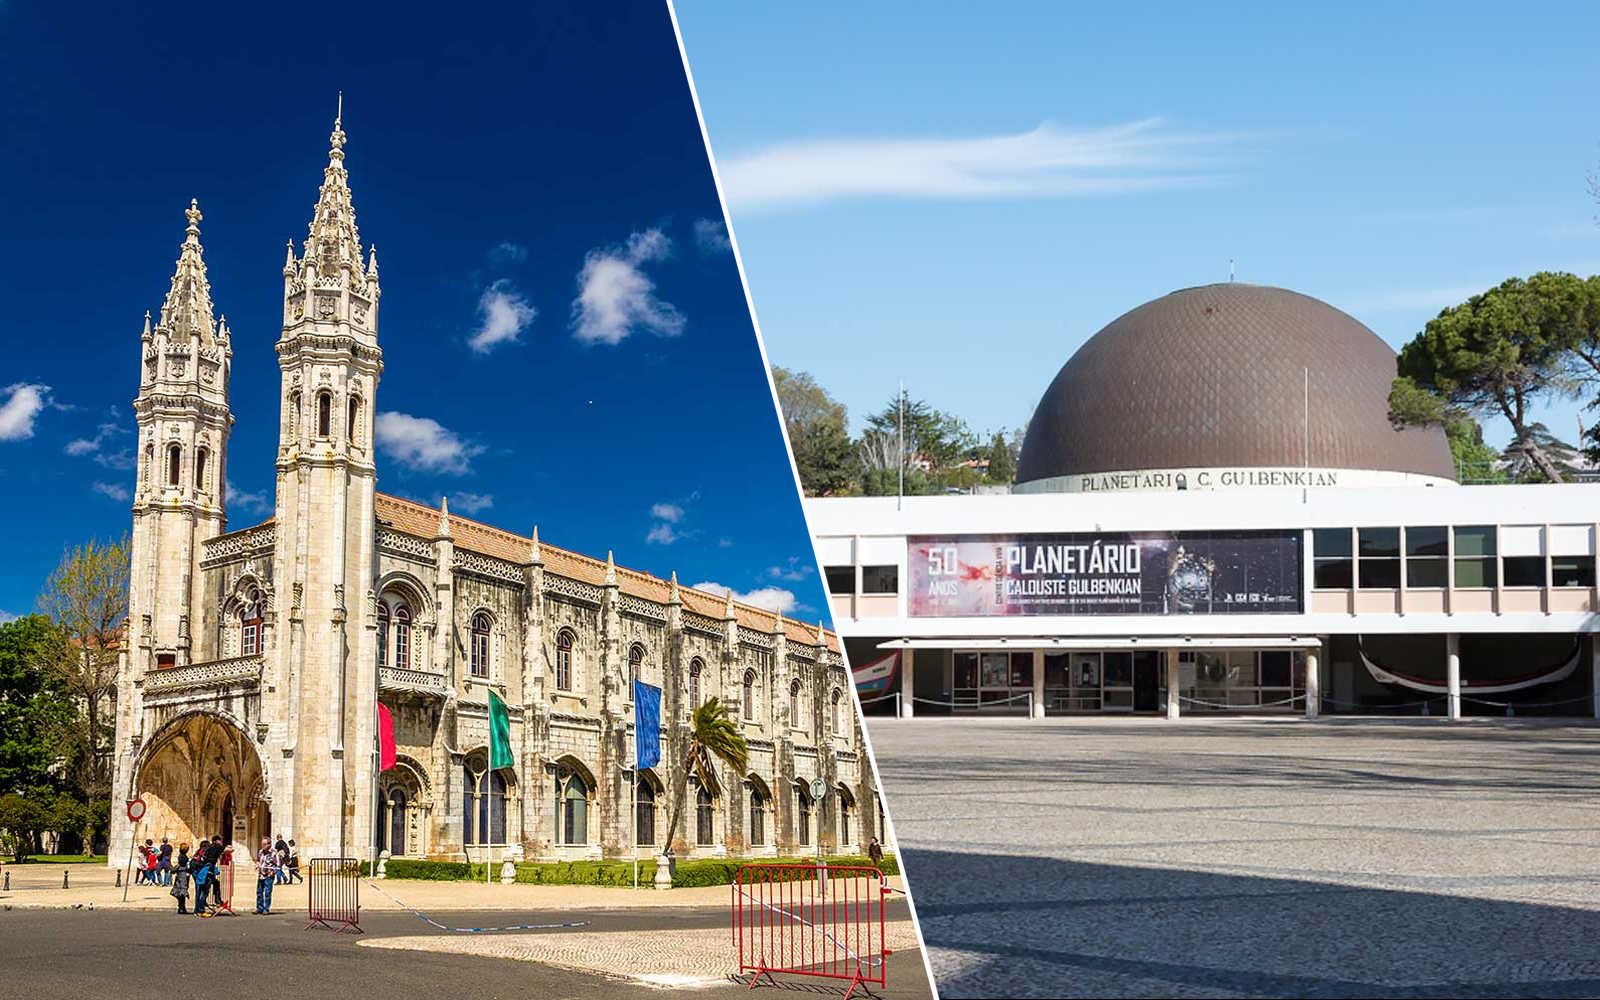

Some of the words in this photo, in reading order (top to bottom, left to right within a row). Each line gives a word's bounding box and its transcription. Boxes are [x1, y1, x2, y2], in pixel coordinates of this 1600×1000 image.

[1220, 471, 1337, 486] GULBENKIAN
[928, 547, 958, 576] 50
[1006, 539, 1141, 574] PLANETÁRIO
[928, 580, 958, 596] ANOS
[1006, 578, 1066, 595] CALOUSTE
[1068, 578, 1141, 595] GULBENKIAN
